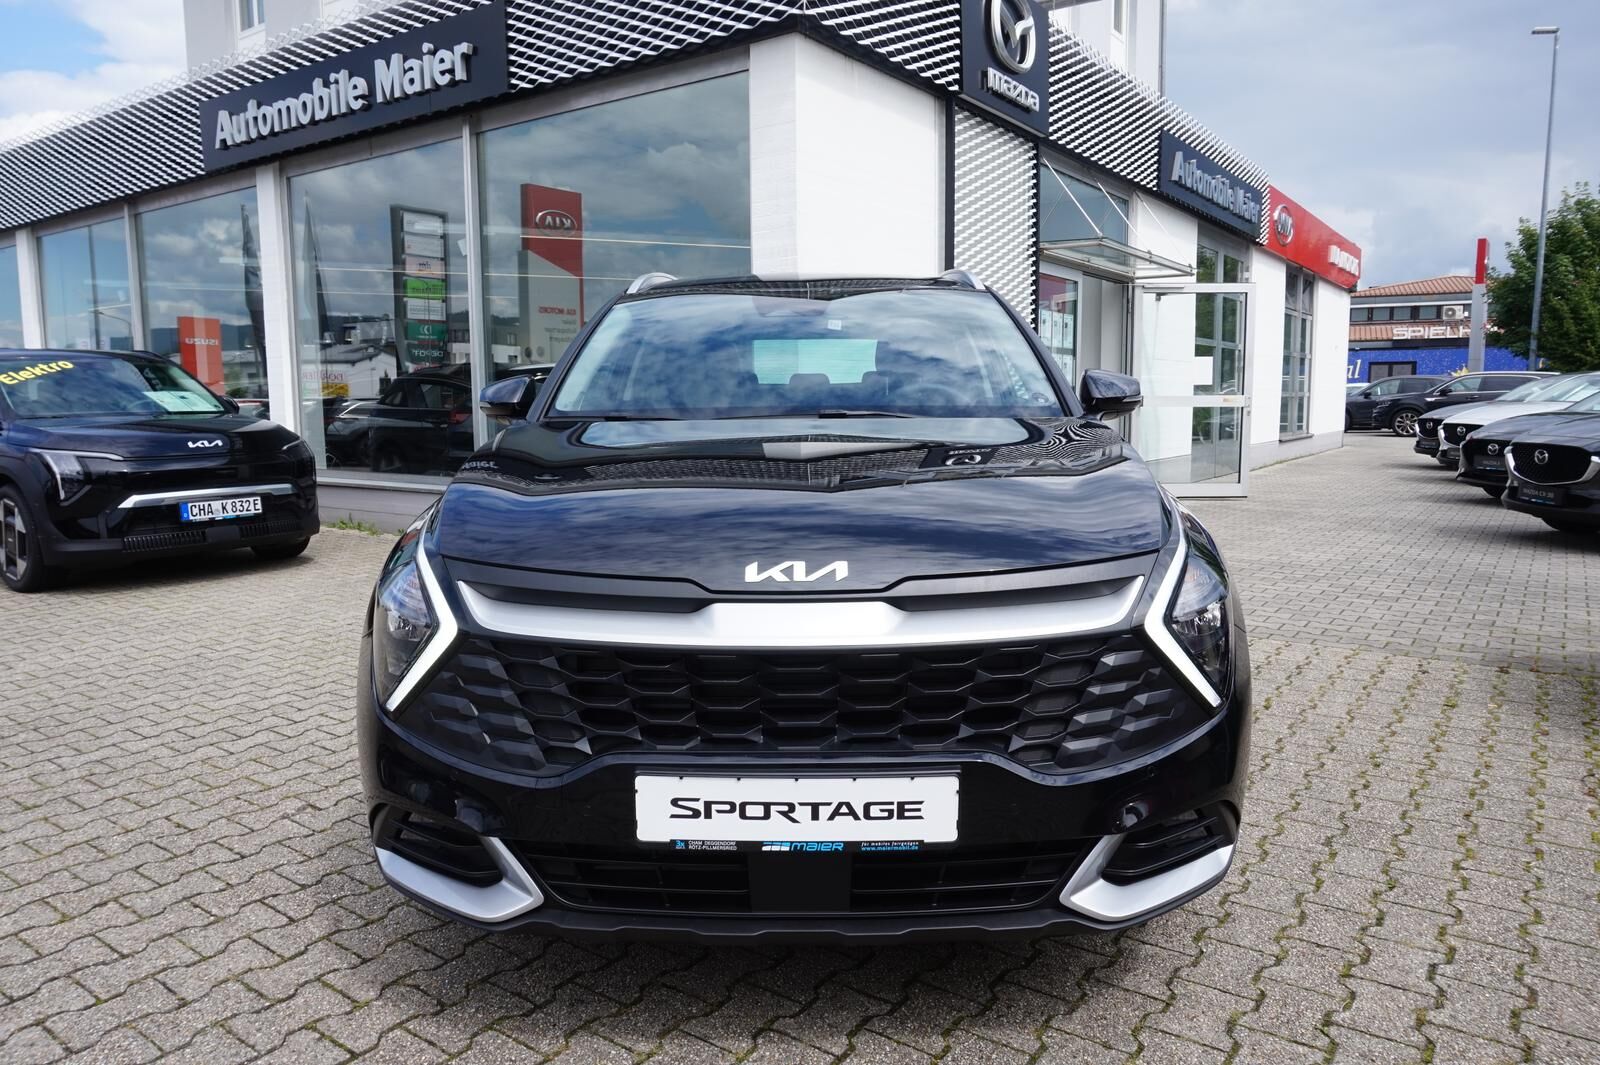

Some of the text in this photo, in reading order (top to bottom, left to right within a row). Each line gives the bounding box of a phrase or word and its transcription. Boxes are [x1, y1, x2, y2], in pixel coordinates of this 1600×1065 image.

[215, 42, 473, 149] Automobile Maier
[1171, 151, 1234, 212] Automobile
[0, 361, 75, 385] Elektro
[190, 503, 214, 518] CHA
[745, 560, 848, 583] KIA
[669, 797, 925, 824] SPORTAGE
